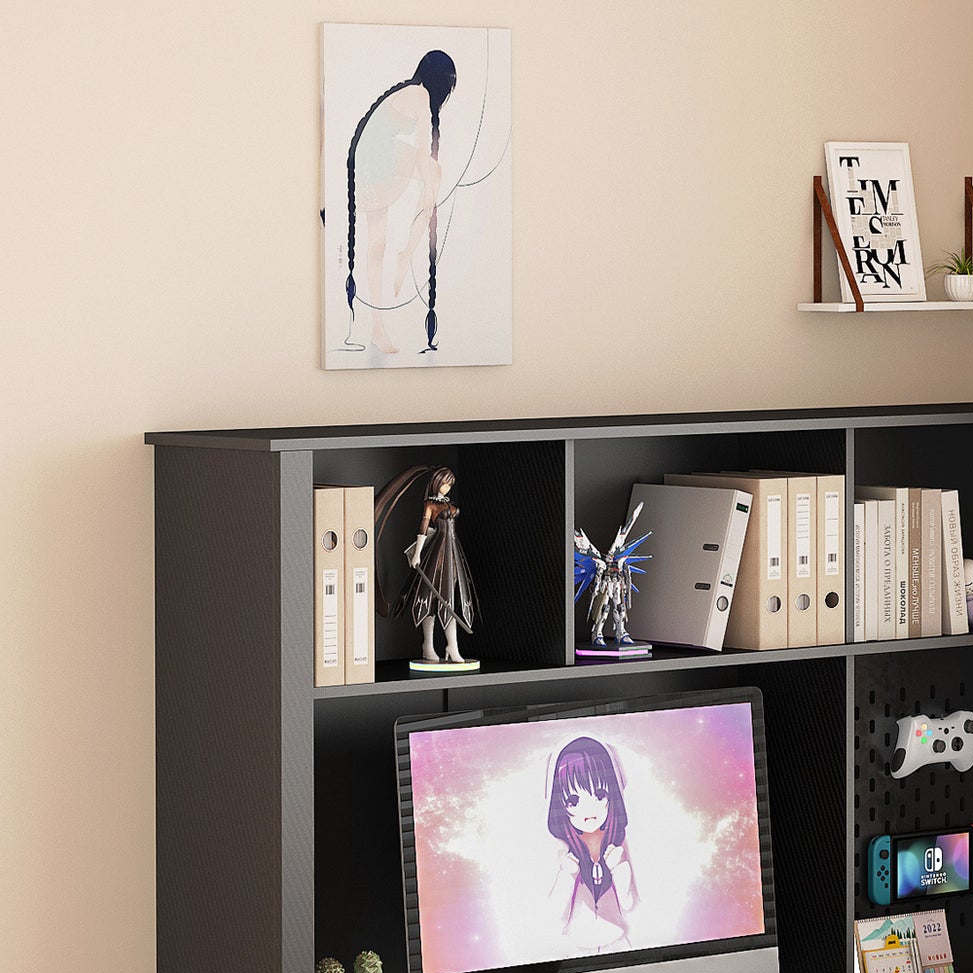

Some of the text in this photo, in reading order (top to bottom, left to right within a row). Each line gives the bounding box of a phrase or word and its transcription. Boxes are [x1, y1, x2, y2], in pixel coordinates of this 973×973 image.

[883, 524, 891, 557] ЗАБОТА
[948, 509, 964, 616] НОВЫЙ ОБРАЗ ЖИЗНИ
[883, 568, 891, 623] ПРЕДАННЫХ
[911, 596, 919, 624] ЛУЧШЕ
[920, 877, 947, 886] SWITCH
[923, 922, 942, 934] 2022
